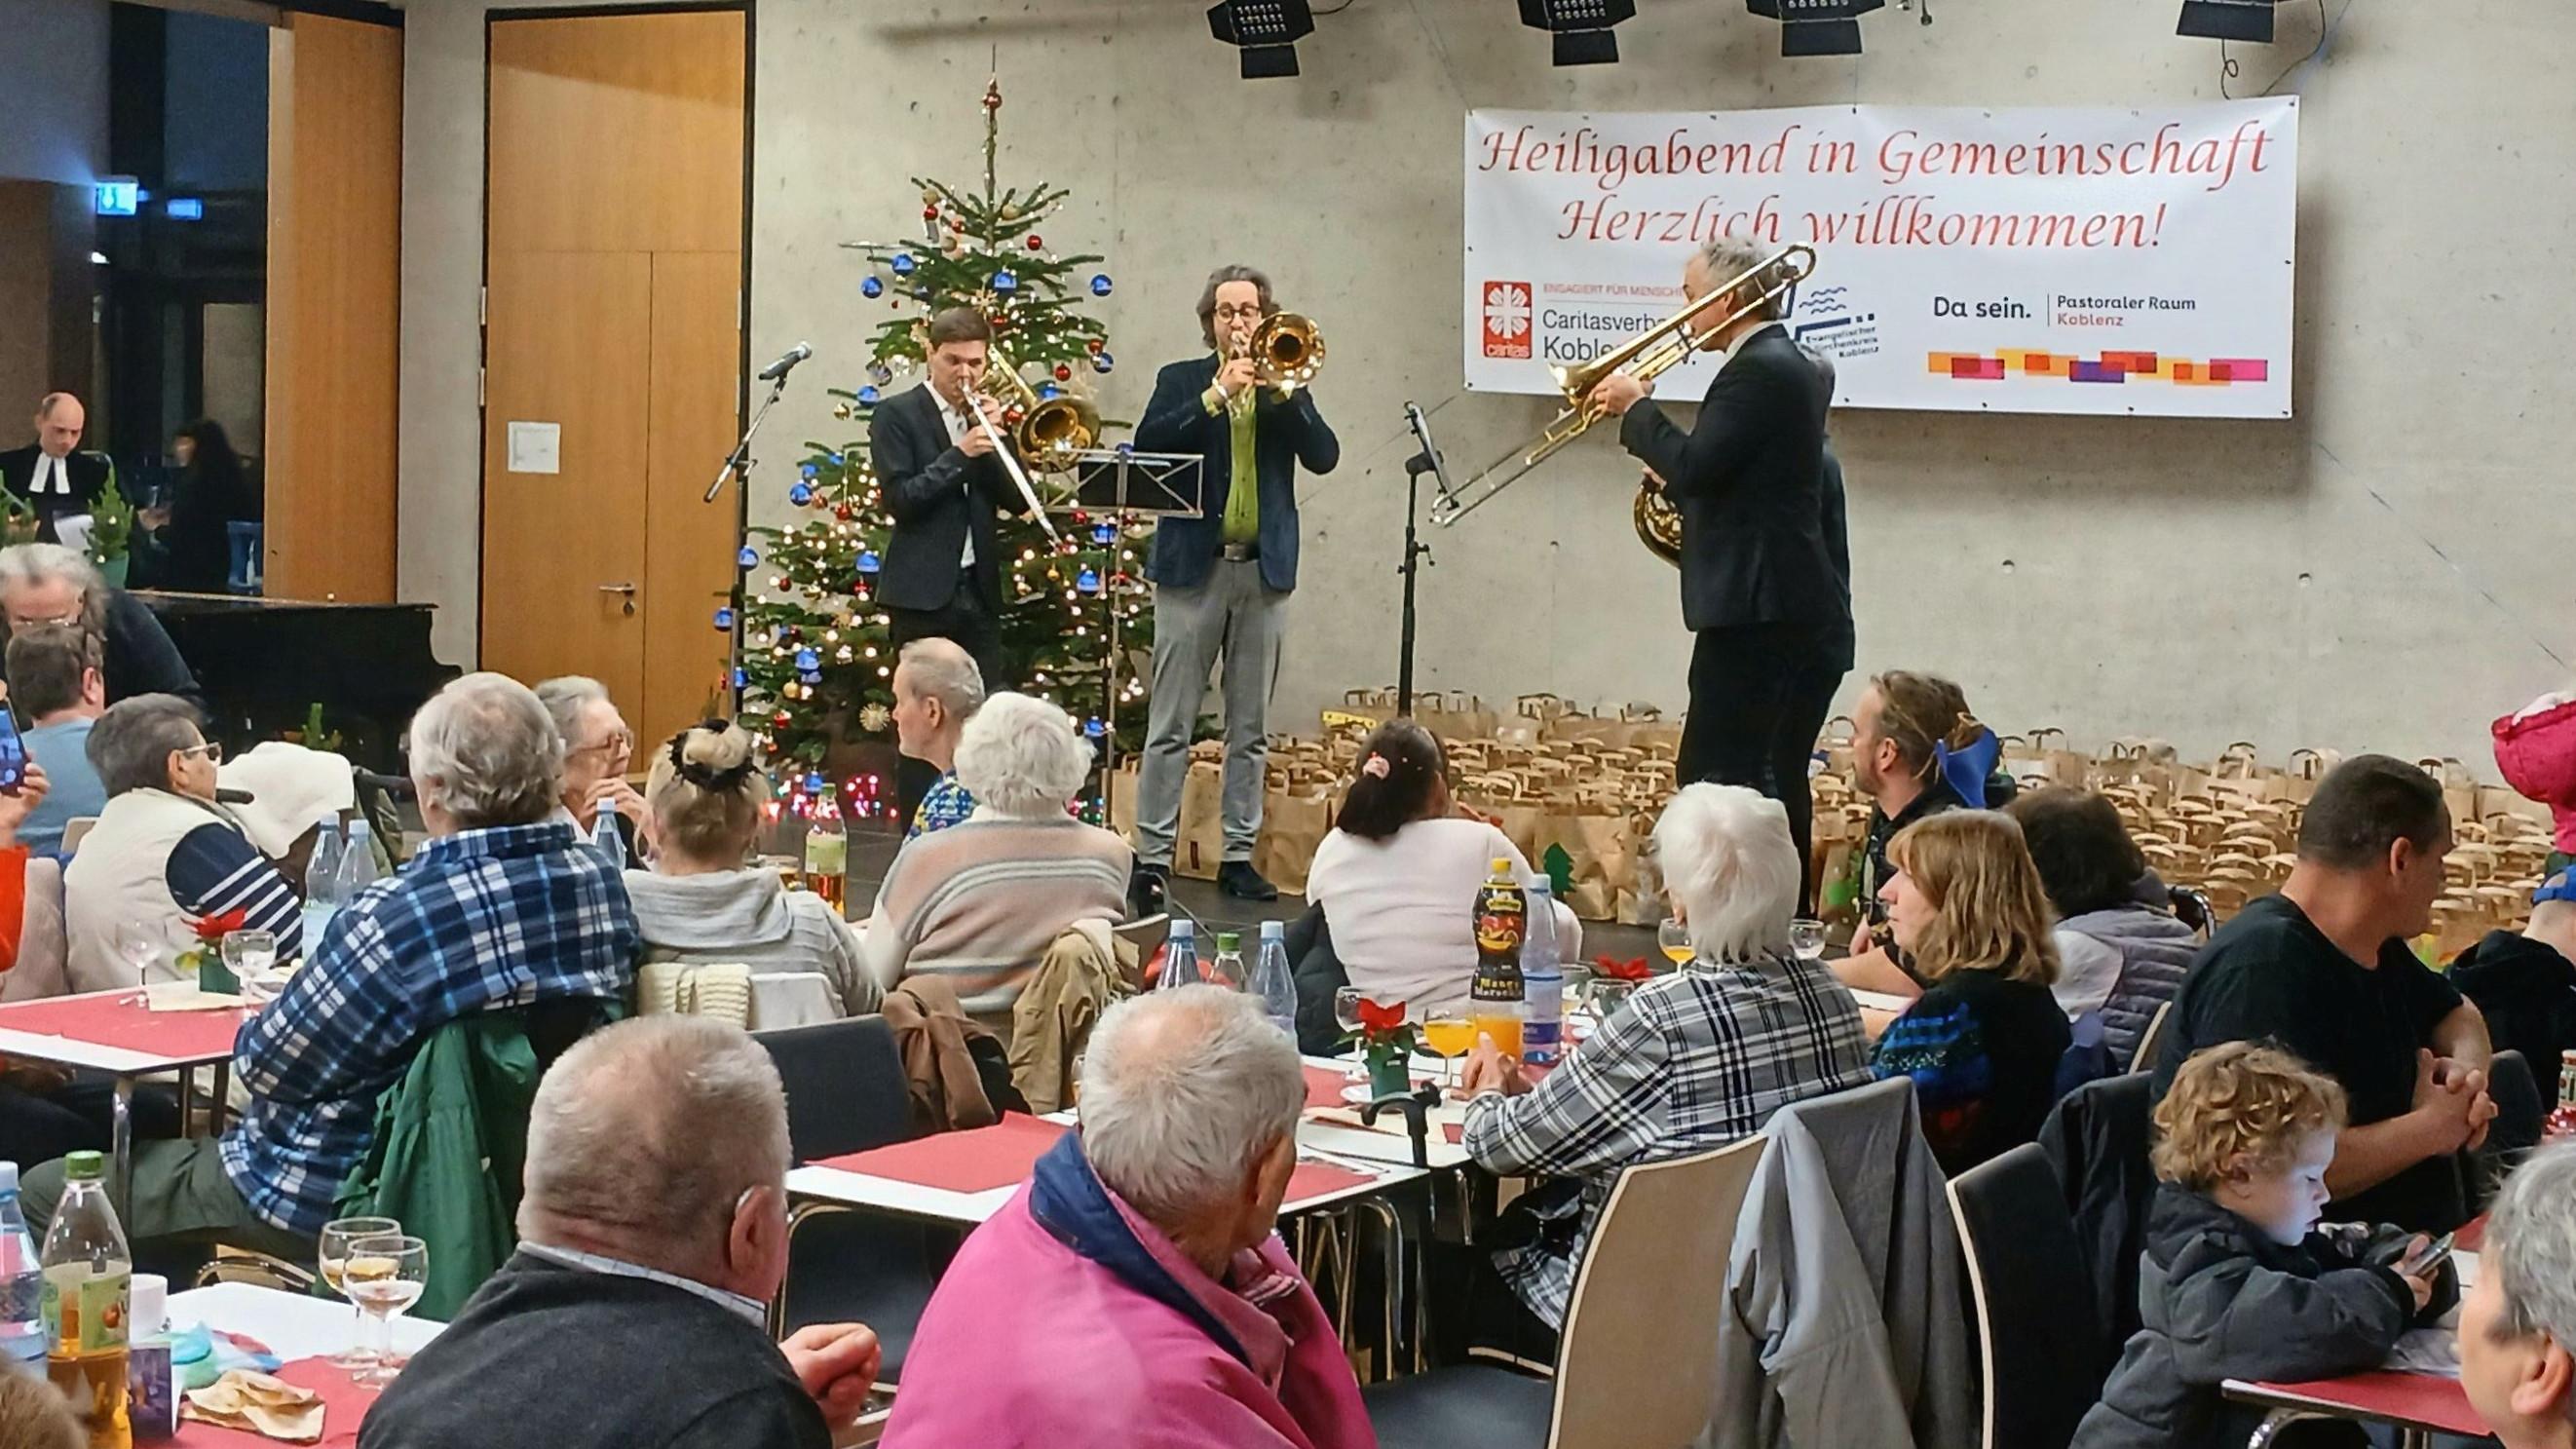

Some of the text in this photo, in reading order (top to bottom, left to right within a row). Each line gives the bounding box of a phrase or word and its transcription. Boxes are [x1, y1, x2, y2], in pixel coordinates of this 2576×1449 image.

[1478, 120, 2274, 192] Heiligabend in Gemeinschaft
[1558, 194, 2167, 248] Herzlich willkommen!
[1543, 283, 1603, 294] ENGAGIERT
[1606, 284, 1628, 296] FÜR
[1934, 296, 2031, 320] Da sein.
[2057, 295, 2196, 311] Pastoraler Raum
[2057, 313, 2124, 327] Koblenz
[1486, 341, 1531, 359] caritas
[1543, 335, 1615, 362] Koble
